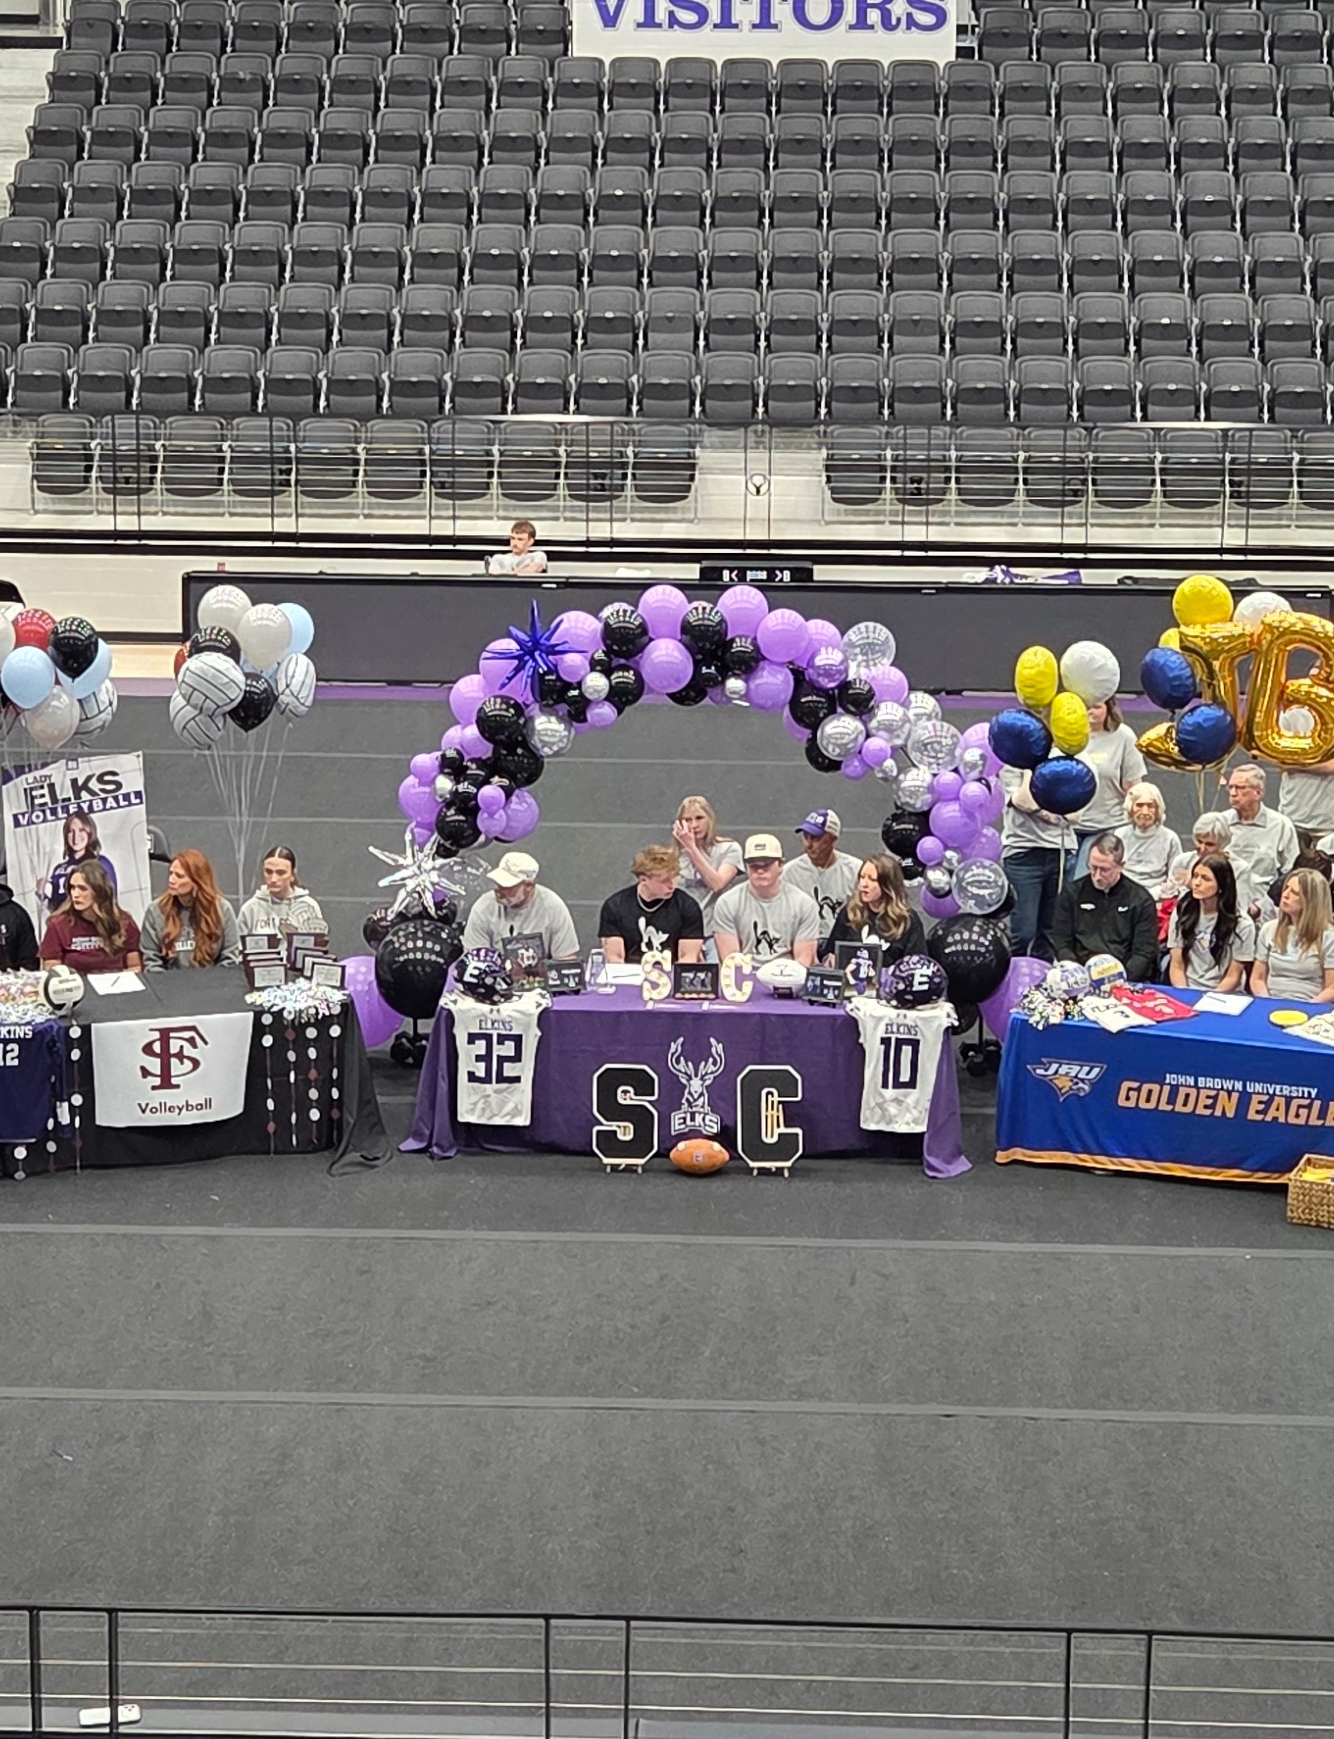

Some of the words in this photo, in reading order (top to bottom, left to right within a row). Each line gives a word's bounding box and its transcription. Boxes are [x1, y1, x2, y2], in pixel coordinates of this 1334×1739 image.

[593, 0, 951, 35] VISITORS
[23, 770, 124, 810] ELKS
[25, 773, 53, 786] LADY
[17, 792, 141, 825] VOLLEYBALL
[641, 950, 672, 1001] S
[720, 952, 754, 1002] C
[478, 1018, 514, 1032] ELKINS
[884, 1023, 919, 1036] ELKINS
[467, 1032, 523, 1084] 32
[880, 1036, 920, 1090] 10
[1117, 1080, 1240, 1119] GOLDEN
[1165, 1073, 1195, 1087] JOHN
[1197, 1077, 1243, 1092] BROWN
[1245, 1081, 1318, 1099] UNIVERSITY
[137, 1097, 213, 1116] Volleyball
[593, 1063, 658, 1165] S
[736, 1065, 803, 1168] C
[673, 1113, 719, 1134] ELKS
